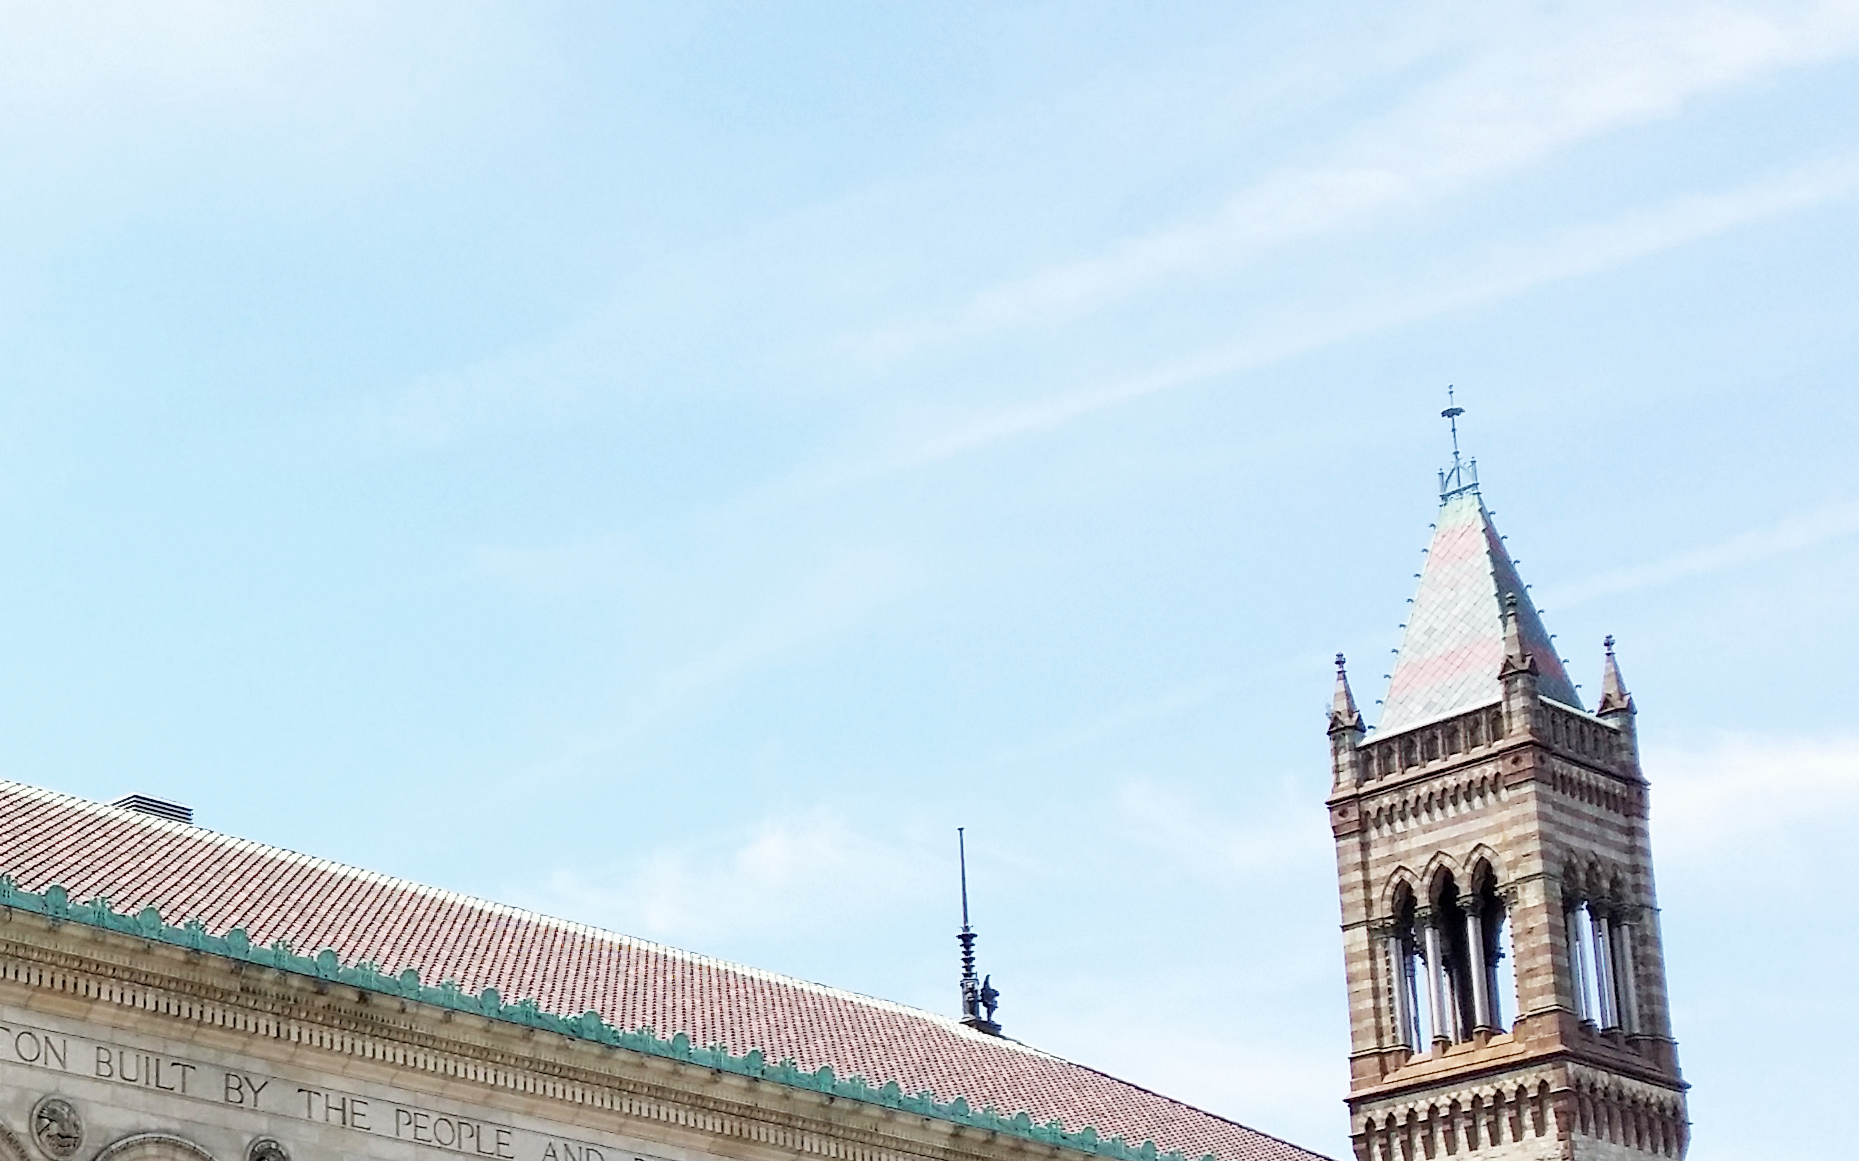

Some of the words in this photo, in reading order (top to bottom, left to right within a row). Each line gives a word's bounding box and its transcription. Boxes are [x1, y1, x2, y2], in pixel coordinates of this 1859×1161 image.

[95, 1045, 197, 1094] BUILT
[224, 1073, 269, 1108] BY
[297, 1088, 372, 1132] THE
[395, 1108, 515, 1160] PEOPLE
